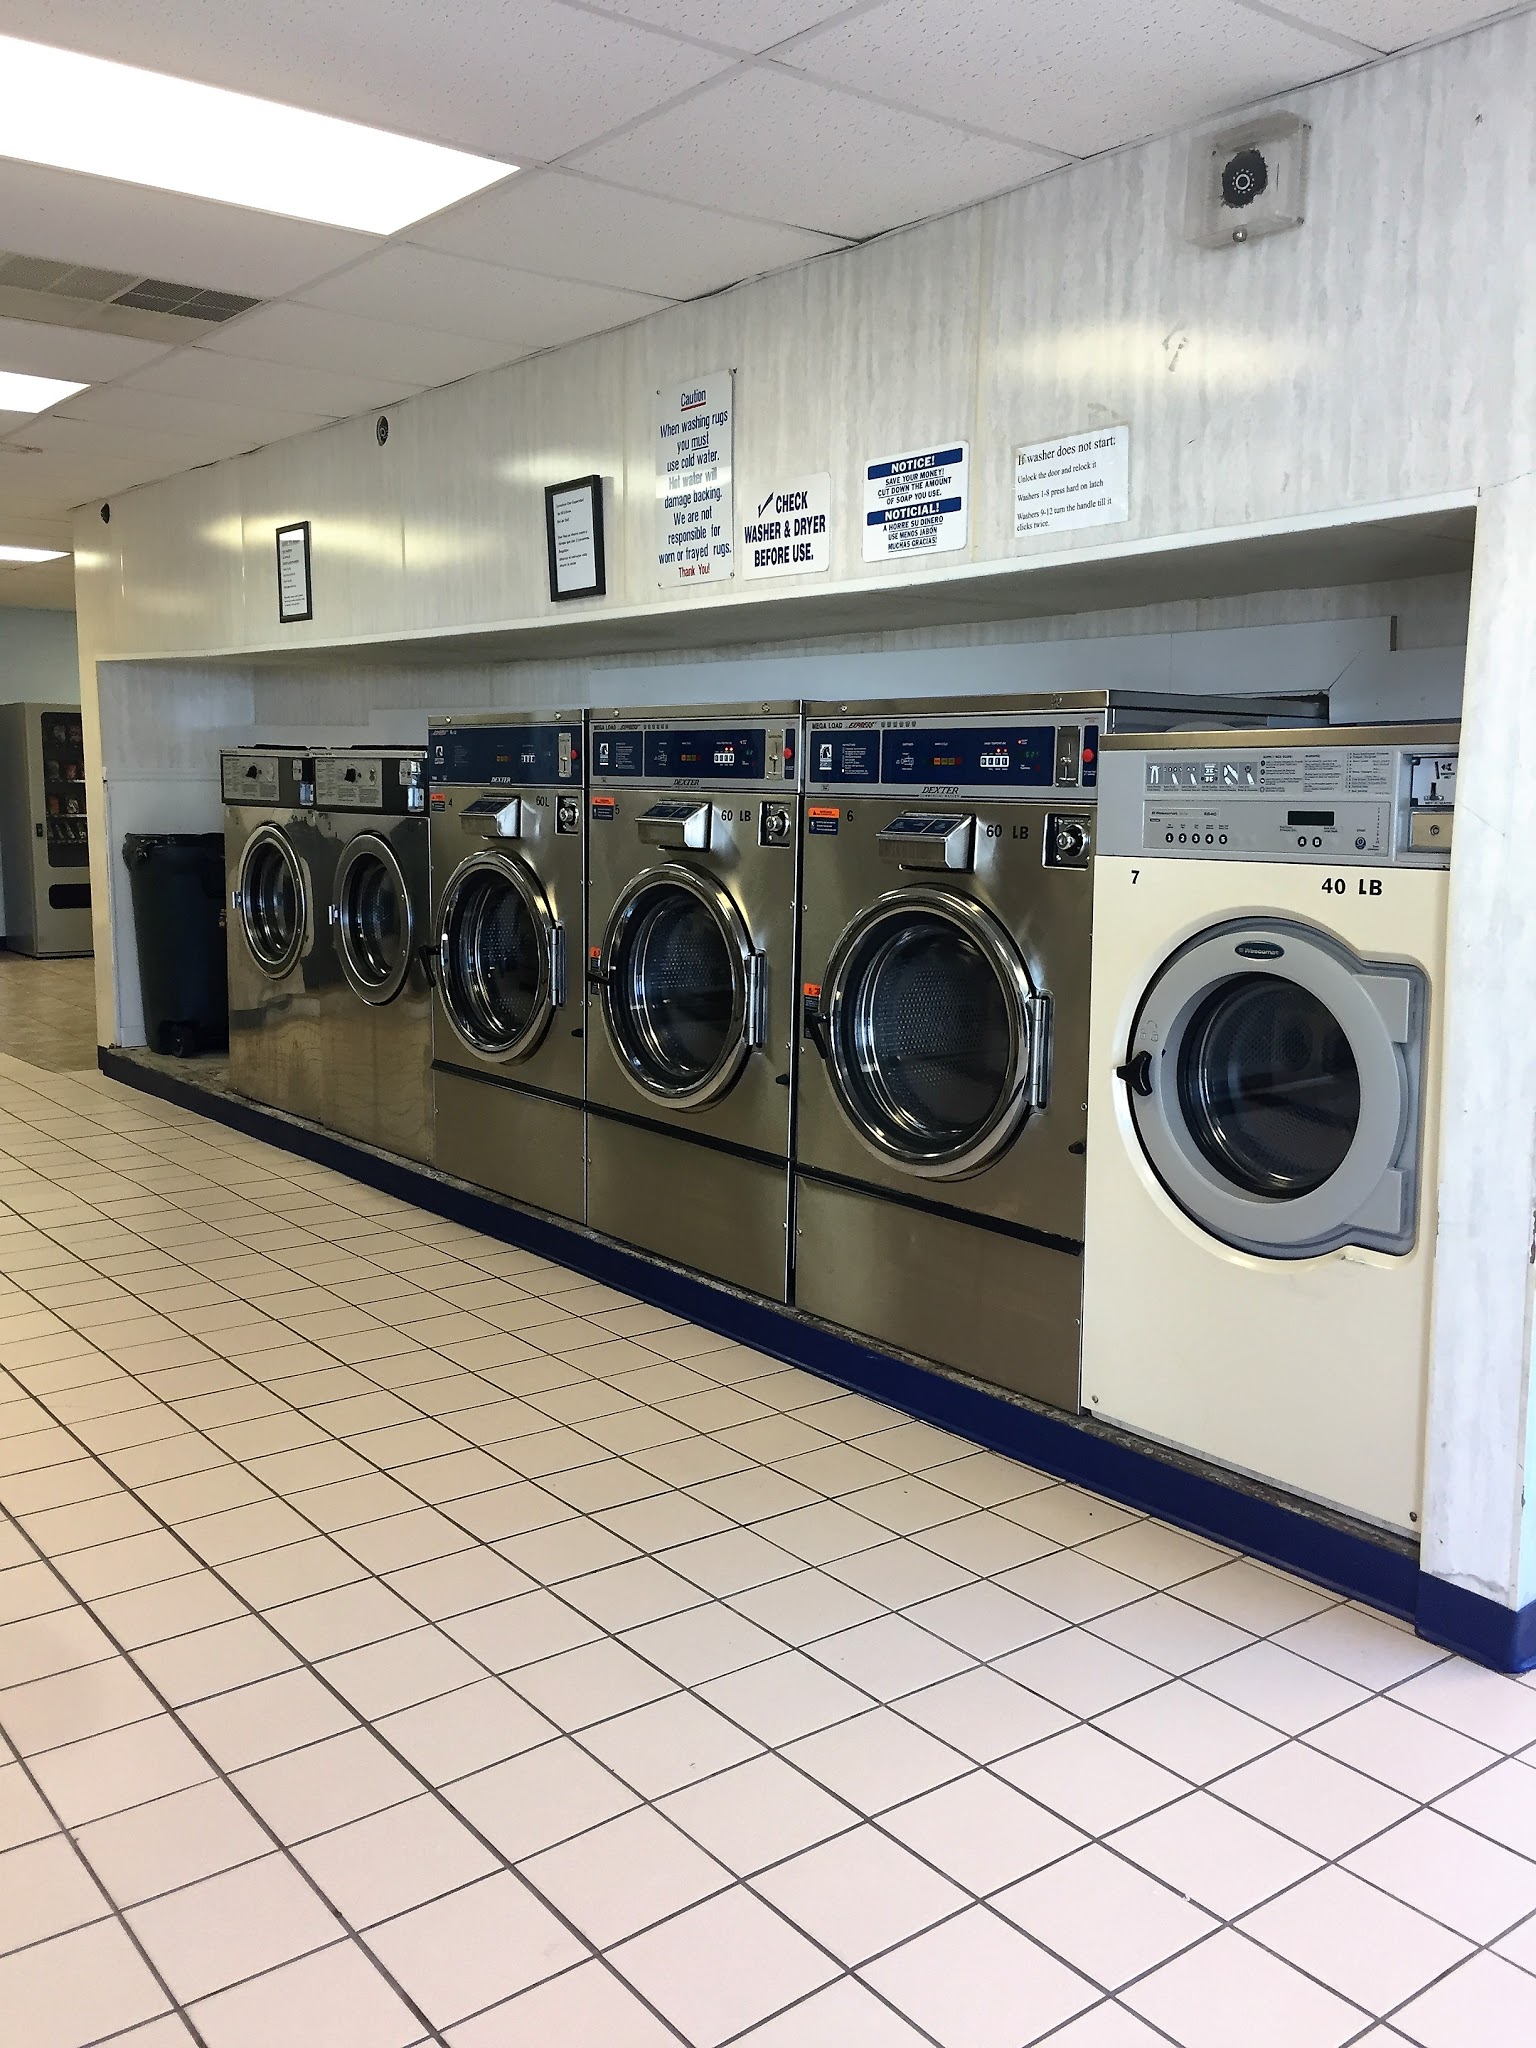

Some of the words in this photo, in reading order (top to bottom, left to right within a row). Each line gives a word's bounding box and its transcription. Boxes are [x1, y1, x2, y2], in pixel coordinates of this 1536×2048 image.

[681, 389, 706, 407] Caution
[660, 423, 680, 438] When
[681, 414, 710, 429] washing
[712, 410, 728, 426] rugs
[677, 440, 689, 454] you
[691, 431, 709, 447] must
[1018, 453, 1025, 465] If
[1027, 449, 1055, 464] washer
[1057, 446, 1076, 457] does
[1078, 441, 1092, 452] not
[1094, 436, 1116, 449] start:
[667, 460, 679, 472] use
[681, 453, 694, 468] cold
[697, 449, 720, 465] water.
[891, 455, 935, 474] NOTICE!
[669, 475, 680, 490] Hot
[683, 472, 702, 487] water
[705, 466, 717, 482] will
[885, 477, 900, 486] SAVE
[902, 473, 918, 482] YOUR
[920, 468, 944, 479] MONEY!
[1018, 473, 1037, 483] Unlock
[1038, 470, 1046, 479] the
[1048, 469, 1060, 478] door
[1061, 466, 1072, 475] and
[1072, 462, 1091, 472] relock
[878, 489, 889, 497] CUT
[892, 485, 909, 494] DOWN
[911, 482, 923, 490] THE
[925, 477, 952, 488] AMOUNT
[1018, 492, 1040, 502] Washers
[1041, 489, 1049, 497] 1-8
[1050, 487, 1065, 498] press
[1066, 484, 1079, 494] hard
[1089, 479, 1104, 488] latch
[665, 494, 691, 508] damage
[694, 486, 722, 502] backing.
[776, 491, 808, 514] CHECK
[887, 497, 894, 505] OF
[896, 494, 912, 503] SOAP
[915, 492, 927, 500] YOU
[928, 489, 942, 497] USE.
[674, 512, 685, 526] We
[688, 511, 698, 522] are
[701, 506, 712, 520] not
[885, 503, 940, 521] NOTICIAL!
[1017, 510, 1040, 520] Washers
[1041, 507, 1053, 516] 9-12
[1067, 504, 1075, 512] the
[1077, 500, 1096, 510] handle
[1097, 498, 1106, 507] till
[1107, 496, 1112, 504] it
[745, 522, 781, 544] WASHER
[784, 520, 791, 538] &
[794, 514, 826, 536] DRYER
[889, 521, 909, 531] HORRE
[920, 516, 943, 526] DINERO
[1016, 521, 1032, 532] clicks
[1033, 520, 1050, 528] twice.
[668, 526, 706, 546] responsible
[711, 524, 720, 537] for
[888, 540, 910, 550] MUCHAS
[912, 536, 937, 546] GRACIAS!
[900, 529, 918, 539] MENOS
[659, 551, 675, 564] worn
[677, 550, 683, 561] or
[686, 543, 708, 561] frayed
[713, 543, 731, 557] rugs.
[755, 546, 789, 567] BEFORE
[793, 543, 814, 562] USE.
[678, 565, 695, 578] Thank
[698, 562, 710, 575] You!
[922, 786, 959, 794] DEXTER
[615, 804, 620, 814] 5
[721, 810, 733, 821] 60
[740, 810, 751, 822] LB
[847, 810, 854, 821] 6
[986, 824, 1002, 838] 60
[1013, 826, 1029, 839] LB
[1131, 870, 1140, 884] 7
[1321, 878, 1346, 895] 40
[1359, 878, 1382, 896] LB
